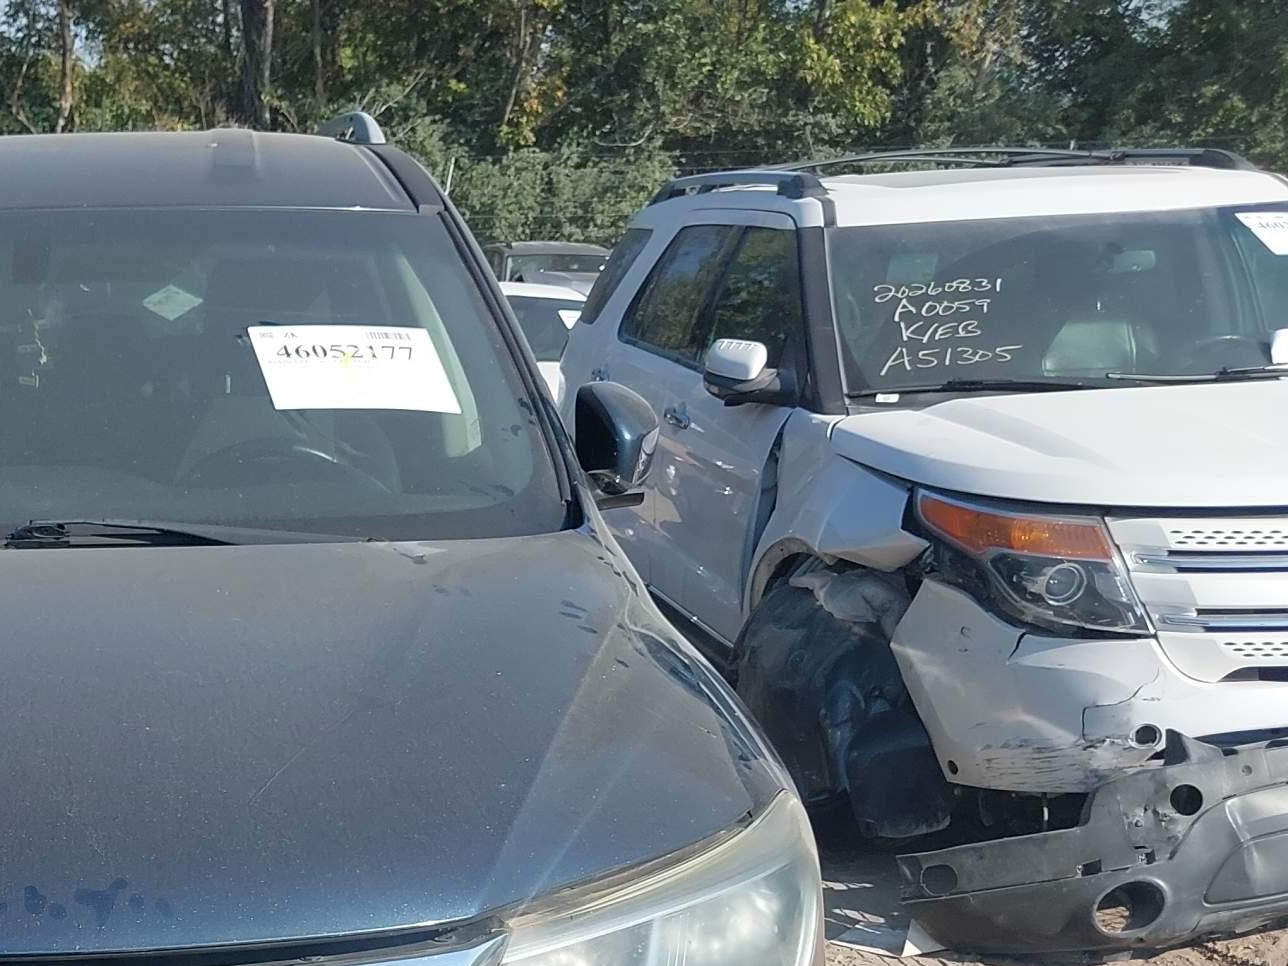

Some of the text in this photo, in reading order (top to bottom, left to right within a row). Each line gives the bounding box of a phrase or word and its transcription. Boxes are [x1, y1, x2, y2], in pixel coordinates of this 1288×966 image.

[873, 278, 1002, 303] 20260831
[894, 298, 991, 322] A0059
[276, 344, 413, 360] 46052177
[880, 345, 1023, 376] A51305
